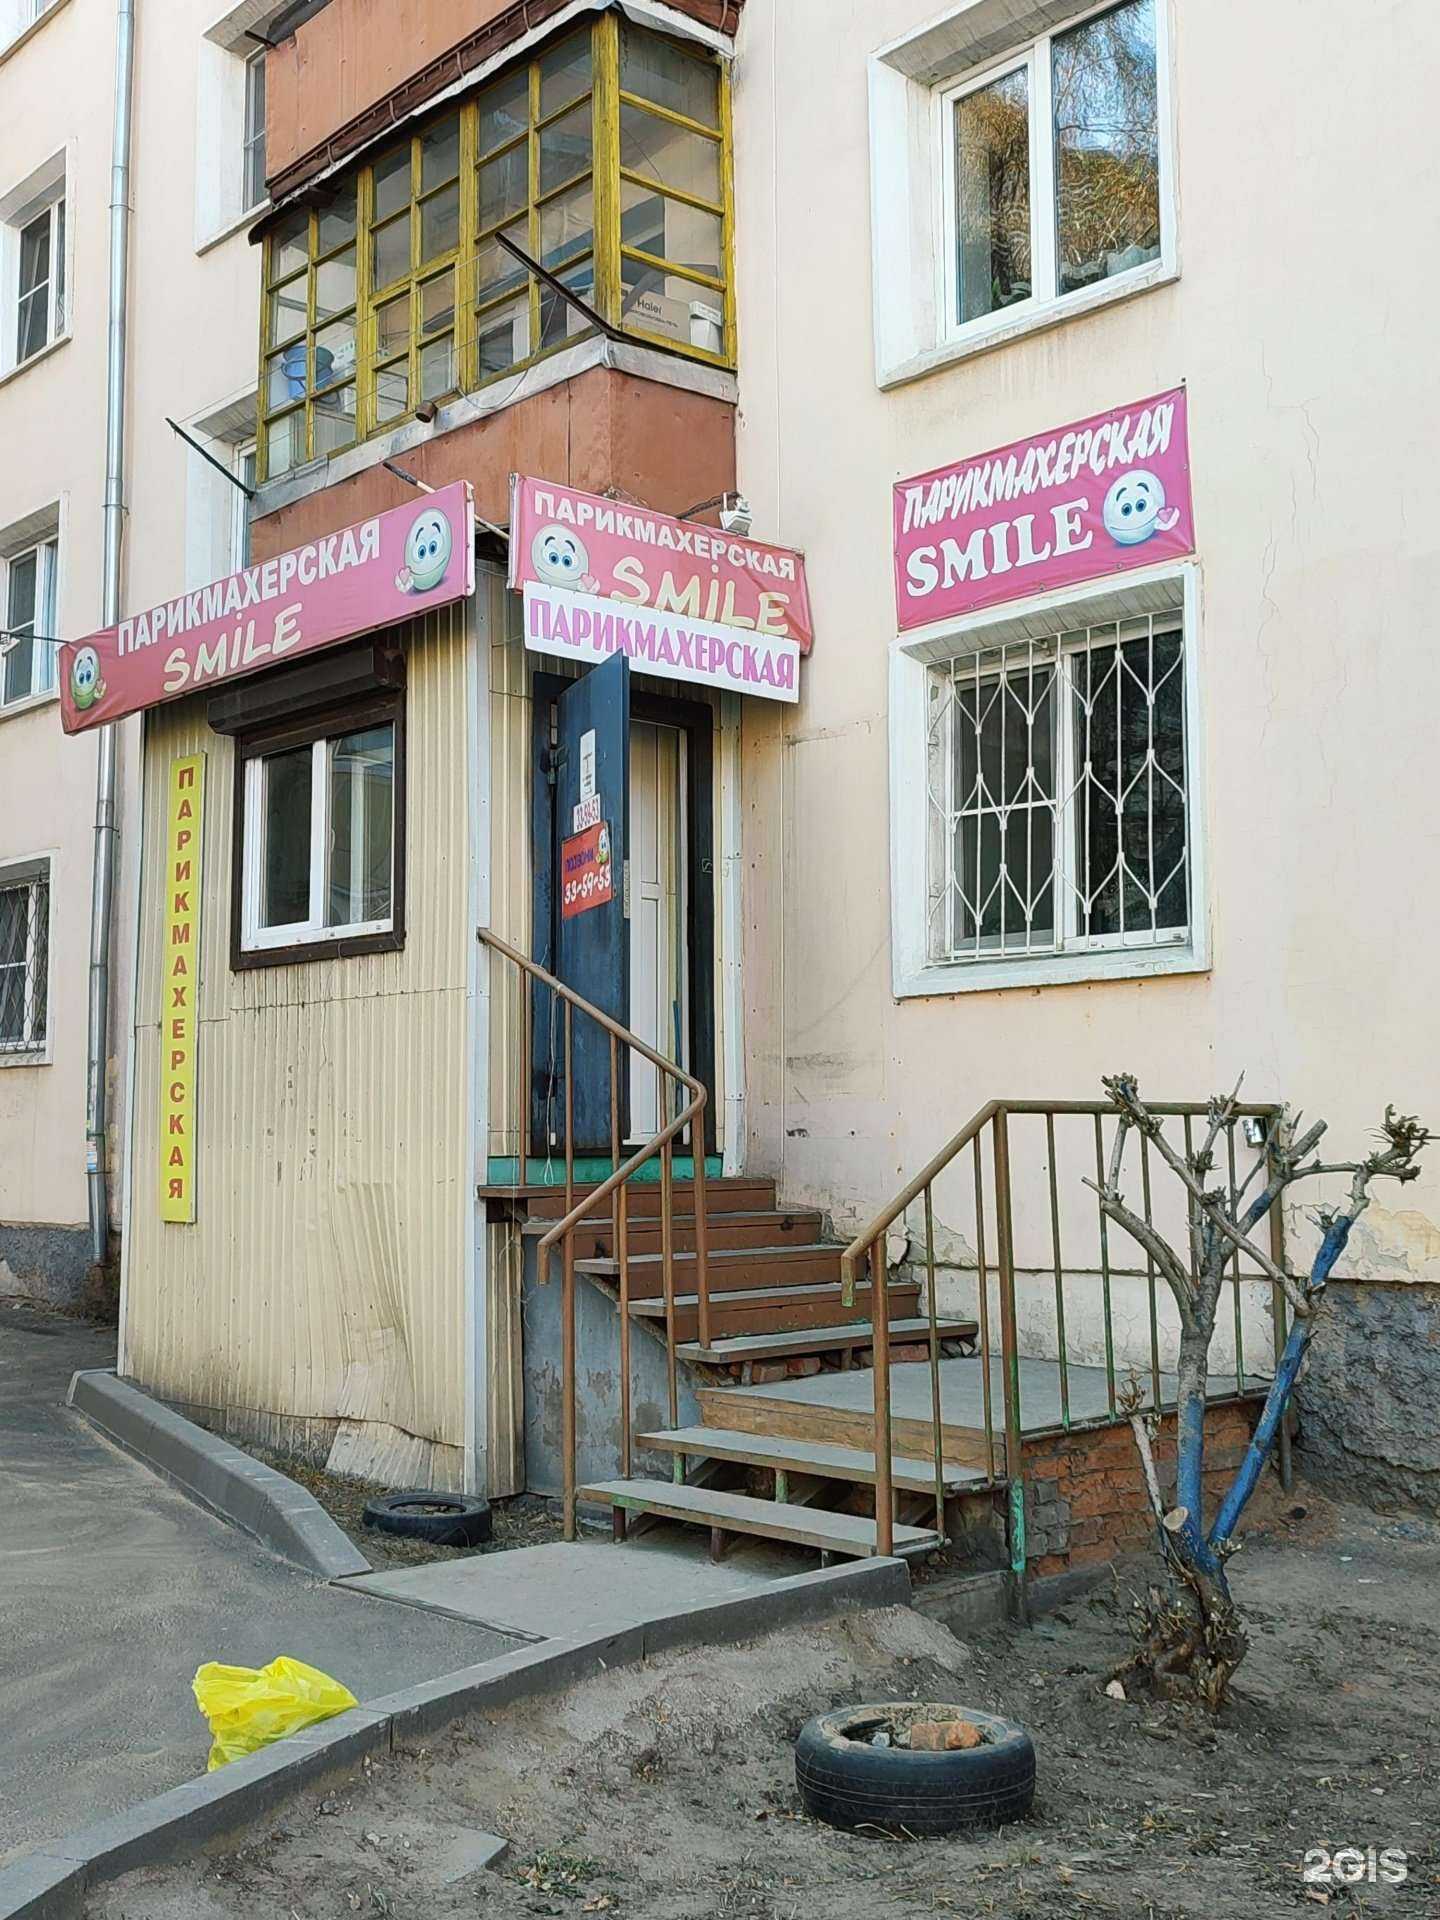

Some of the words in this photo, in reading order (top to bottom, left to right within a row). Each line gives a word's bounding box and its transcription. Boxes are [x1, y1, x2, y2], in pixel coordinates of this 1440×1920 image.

[902, 402, 1174, 535] ПАРИКМАХЕРСКАЯ
[117, 519, 380, 656] ПАРИКМАХЕРСКАЯ
[534, 490, 795, 581] ПАРИКМАХЕРСКАЯ
[905, 497, 1094, 598] SMILE
[530, 598, 795, 690] ПАРИКМАХЕРСКАЯ
[168, 766, 195, 1199] ПАРИКМАХЕРСКАЯ
